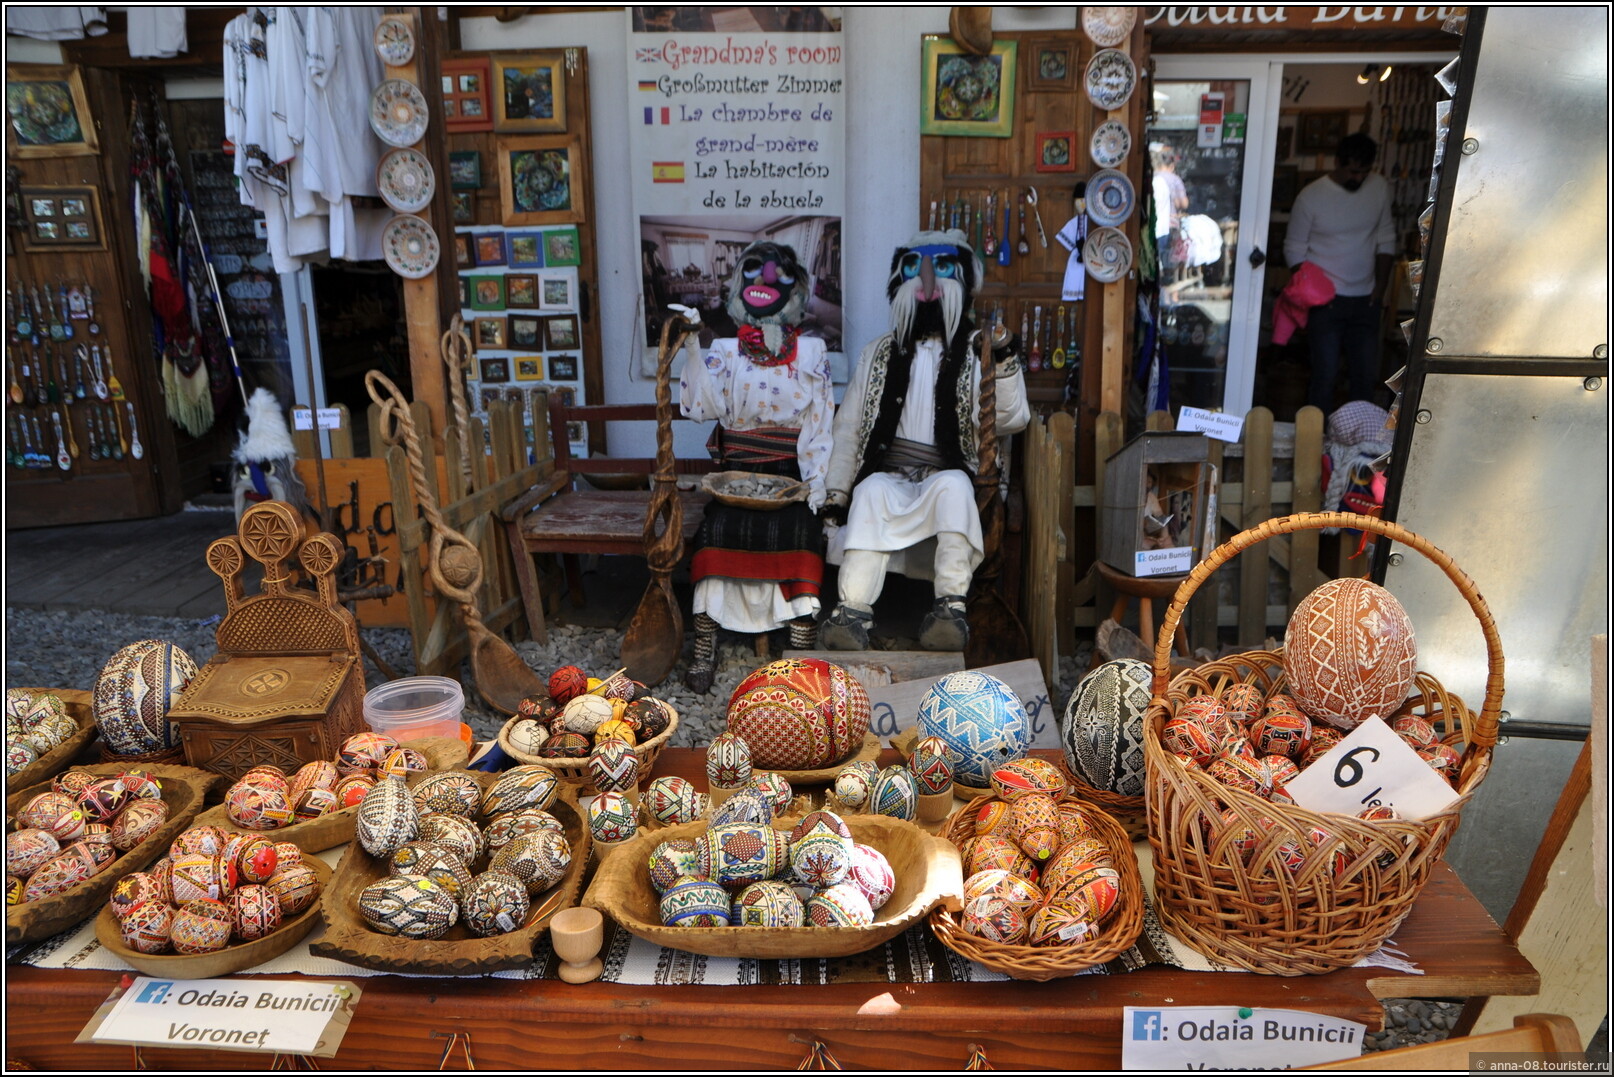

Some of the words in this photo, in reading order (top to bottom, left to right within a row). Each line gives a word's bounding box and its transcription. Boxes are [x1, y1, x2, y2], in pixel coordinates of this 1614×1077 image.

[662, 37, 777, 70] Grandma's
[787, 44, 841, 65] room
[658, 72, 769, 98] Großmutter
[777, 74, 842, 94] Zimmer
[680, 104, 703, 122] La
[712, 102, 802, 122] chambre
[811, 103, 833, 122] de
[695, 134, 819, 156] grand-mère
[695, 161, 717, 179] La
[726, 159, 830, 180] habitación
[703, 190, 726, 208] de
[735, 190, 751, 209] la
[761, 190, 823, 209] abuela
[1334, 746, 1380, 788] 6
[1361, 787, 1393, 807] le
[177, 990, 249, 1008] Odaia
[254, 993, 340, 1012] Bunicii
[1178, 1020, 1253, 1041] Odaia
[1263, 1020, 1355, 1044] Bunicii
